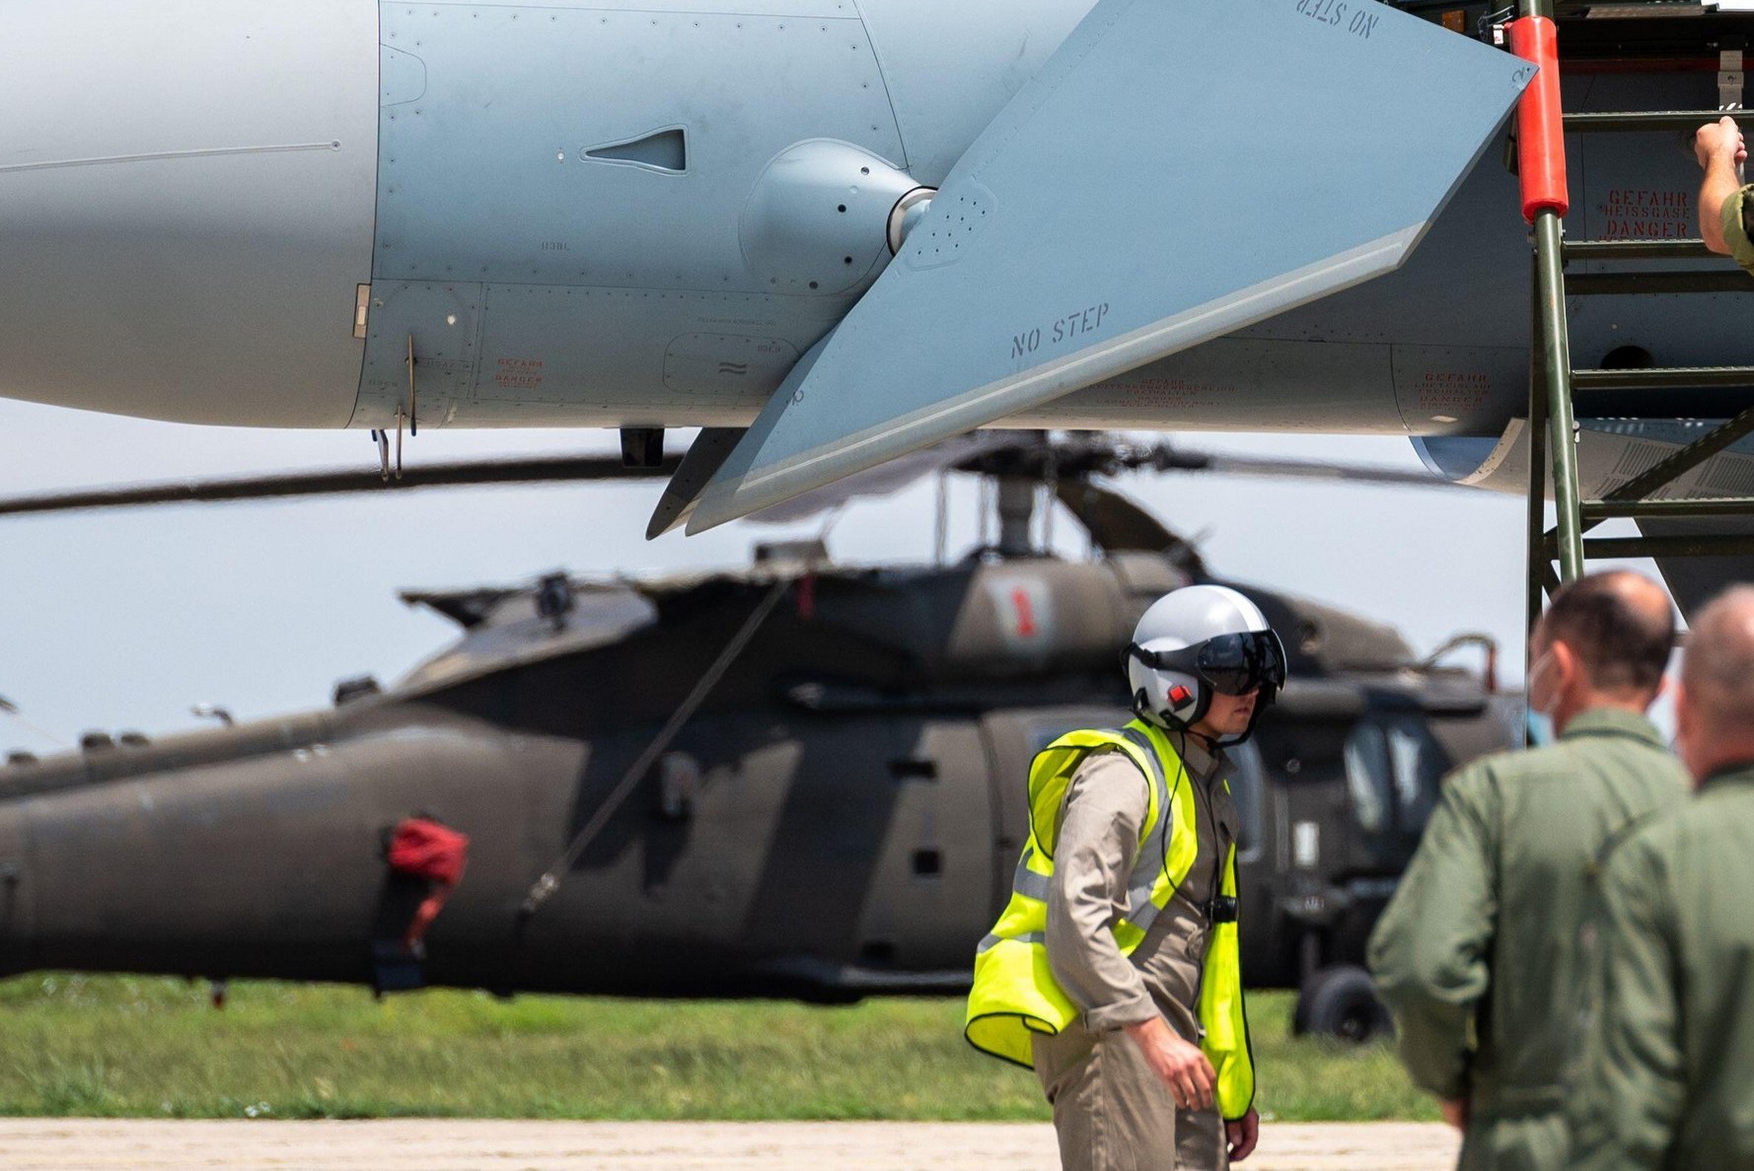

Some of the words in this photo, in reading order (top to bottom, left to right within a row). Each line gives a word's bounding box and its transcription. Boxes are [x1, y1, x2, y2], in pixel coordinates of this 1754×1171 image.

[1348, 9, 1380, 39] NO
[1608, 189, 1688, 207] GEFAHR
[1604, 204, 1690, 219] HEISSGASE
[1606, 220, 1688, 238] DANGER
[1010, 326, 1042, 360] NO
[1051, 301, 1110, 344] STEP
